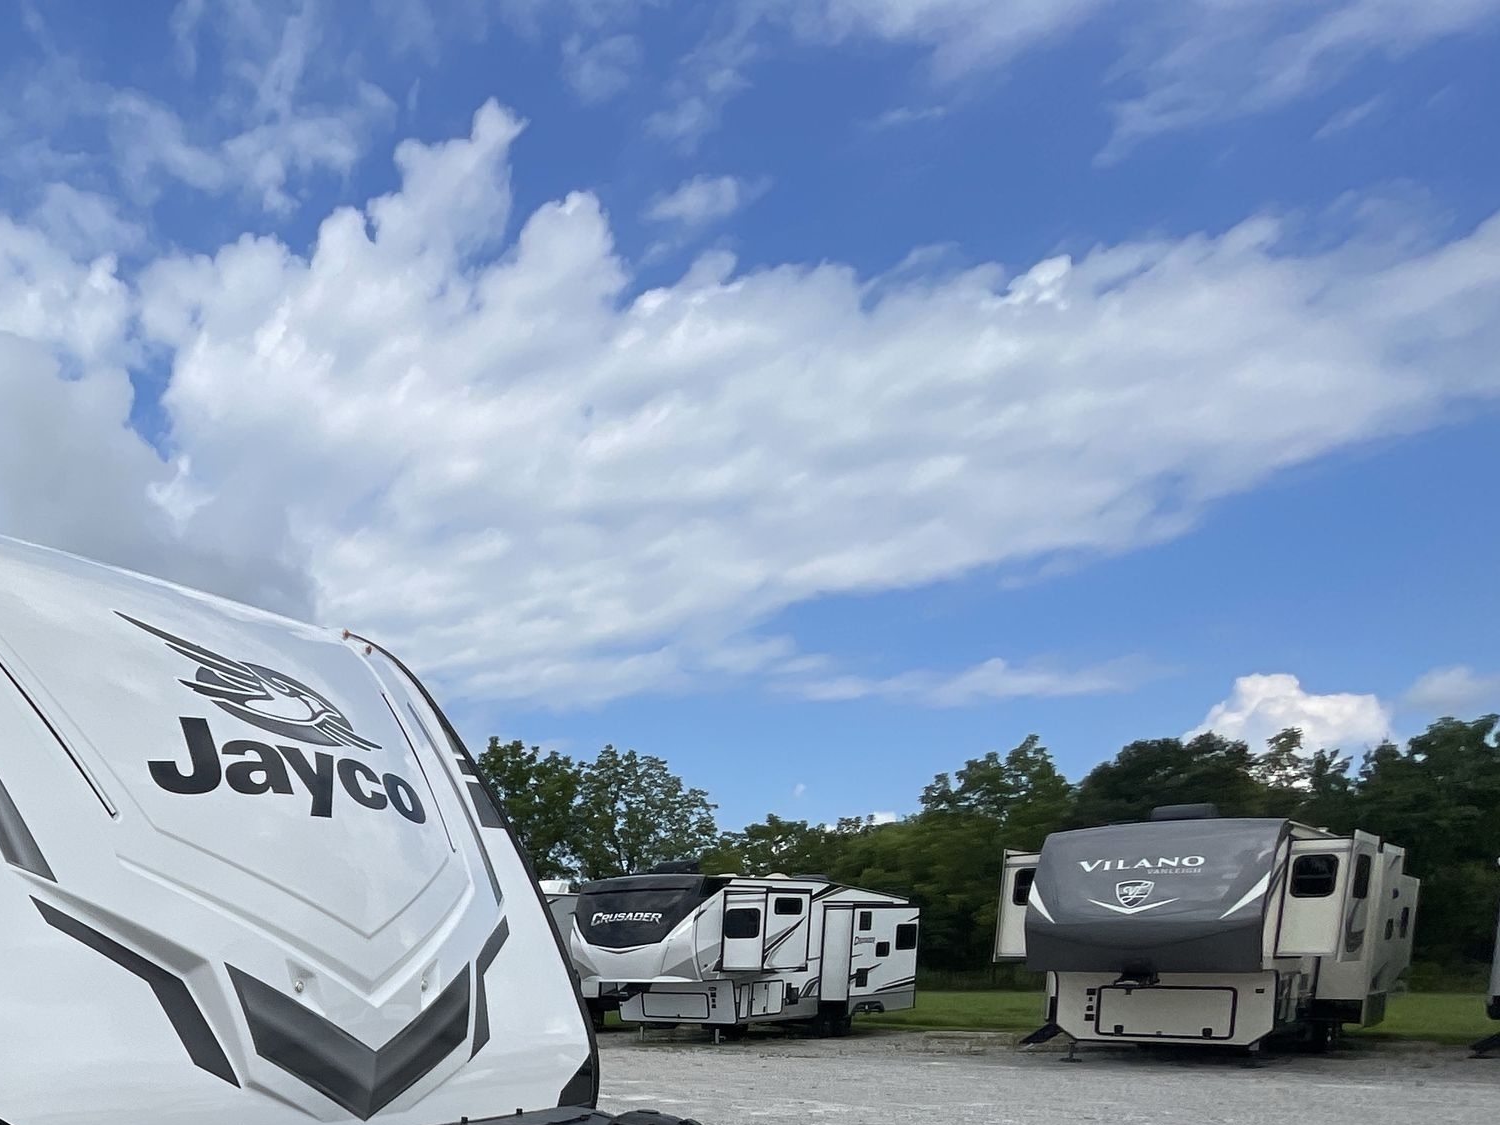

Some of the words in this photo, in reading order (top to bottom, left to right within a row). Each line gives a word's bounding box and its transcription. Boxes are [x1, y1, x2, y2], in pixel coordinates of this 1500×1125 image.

[147, 716, 426, 824] Jayco
[1079, 856, 1205, 872] VILANO
[1147, 867, 1202, 875] VANLEIGH
[591, 912, 662, 926] CRUSADER
